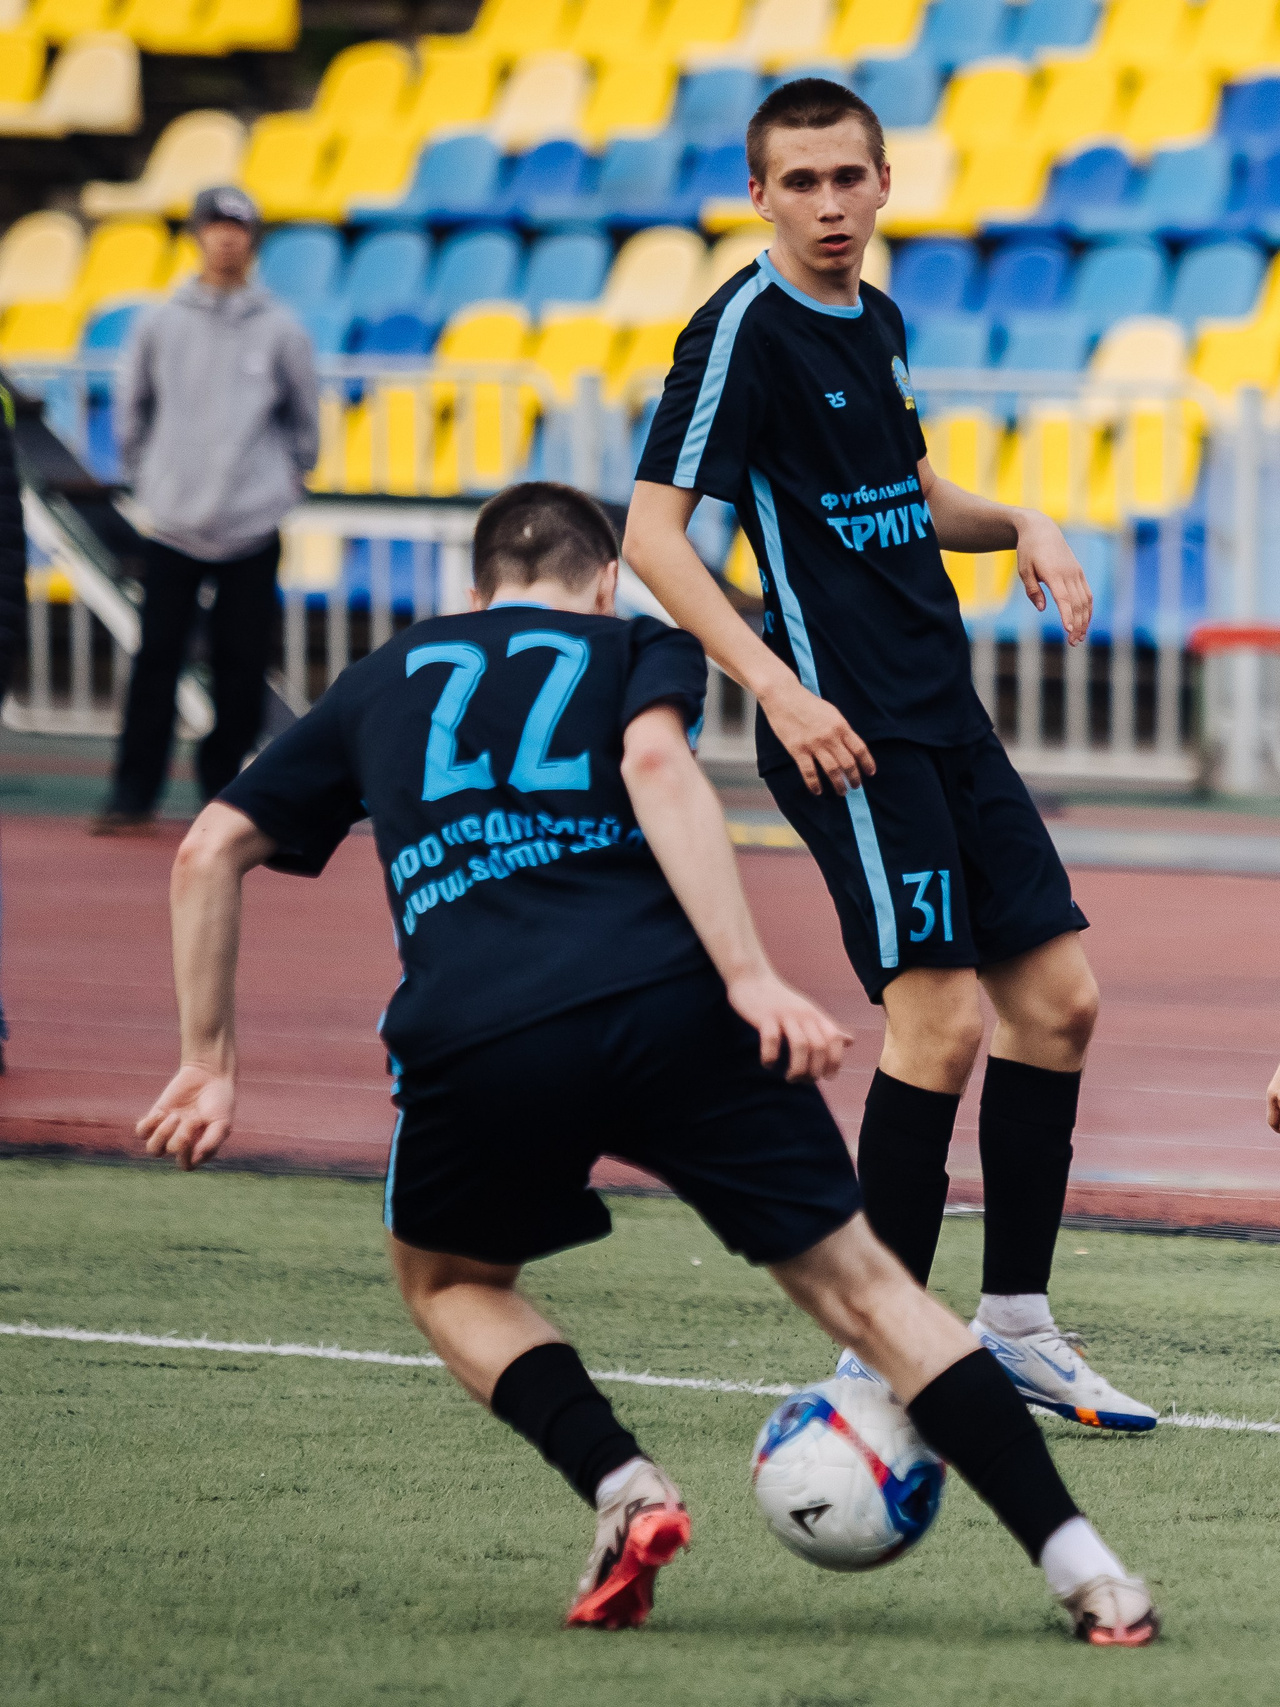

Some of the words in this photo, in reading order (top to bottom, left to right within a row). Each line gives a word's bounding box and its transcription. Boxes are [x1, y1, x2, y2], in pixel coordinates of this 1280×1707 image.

[826, 499, 935, 552] ТРИУМ
[405, 628, 592, 802] 22
[902, 869, 954, 943] 31
